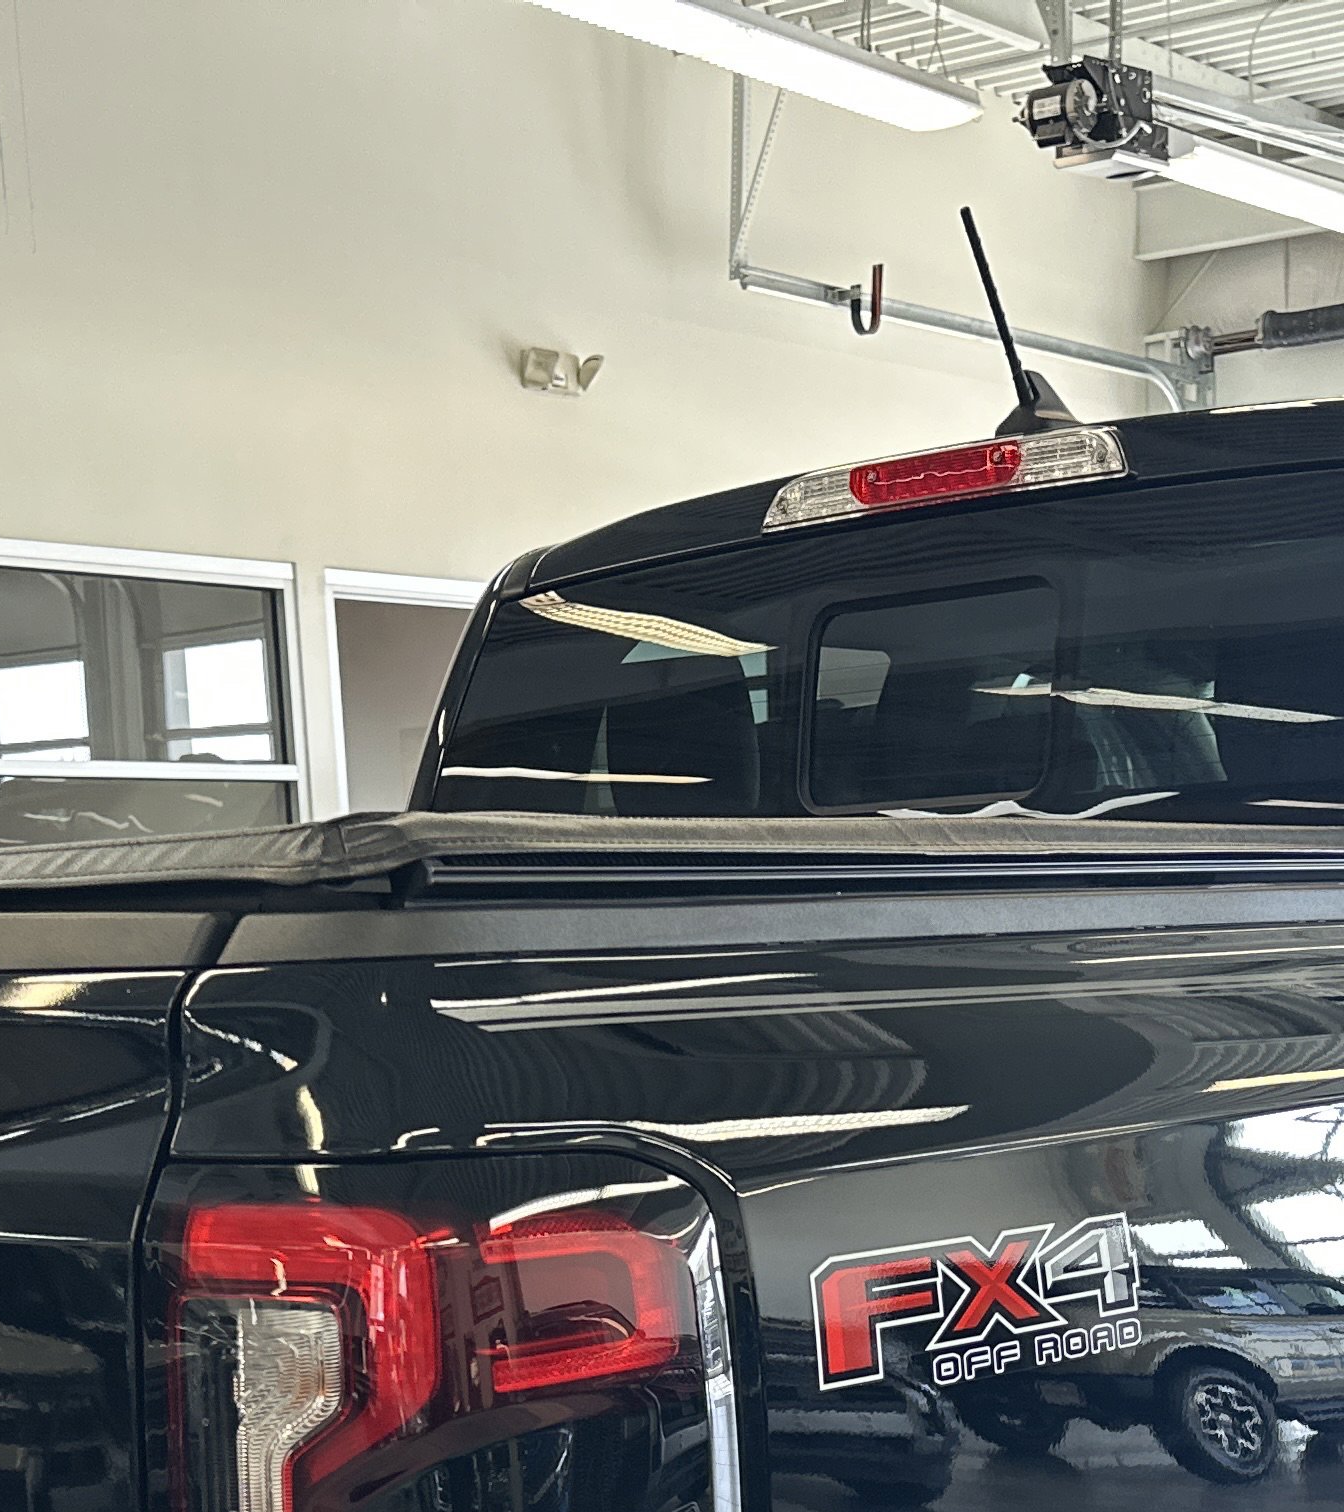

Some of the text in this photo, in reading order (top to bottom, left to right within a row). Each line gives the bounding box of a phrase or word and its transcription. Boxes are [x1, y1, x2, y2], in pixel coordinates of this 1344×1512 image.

[810, 1212, 1139, 1391] FX4
[933, 1317, 1142, 1386] OFF ROAD
